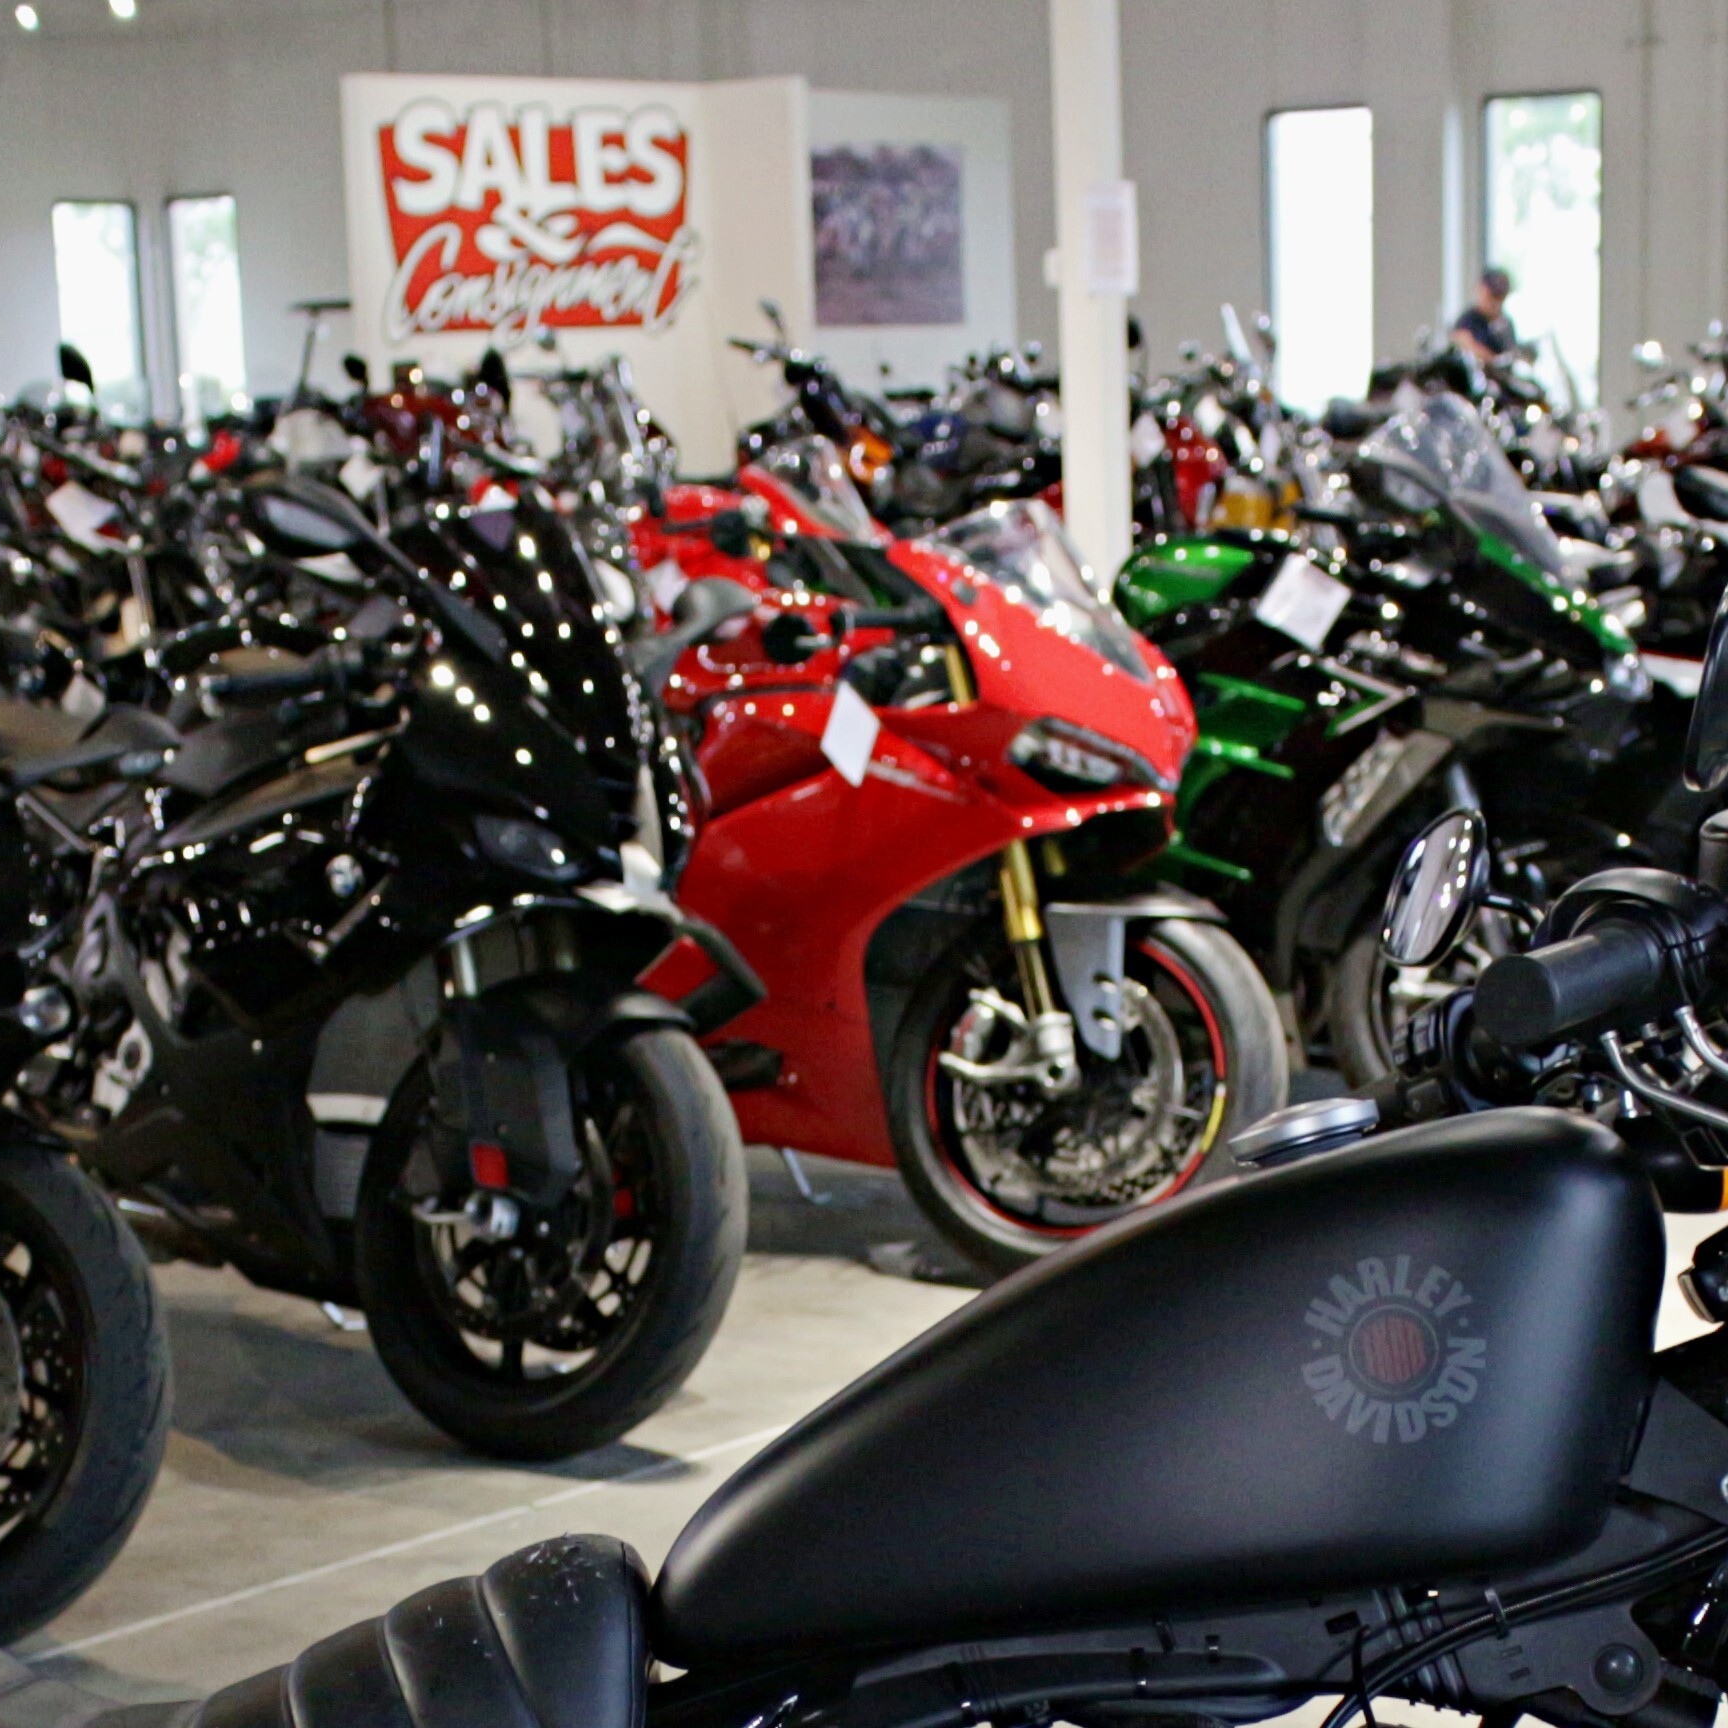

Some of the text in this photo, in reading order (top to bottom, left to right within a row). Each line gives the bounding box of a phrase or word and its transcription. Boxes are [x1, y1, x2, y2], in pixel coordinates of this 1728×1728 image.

[391, 98, 685, 217] SALES
[386, 222, 702, 345] Consignment
[1304, 1254, 1472, 1338] HARLEY
[1301, 1337, 1488, 1444] DAVIDSON
